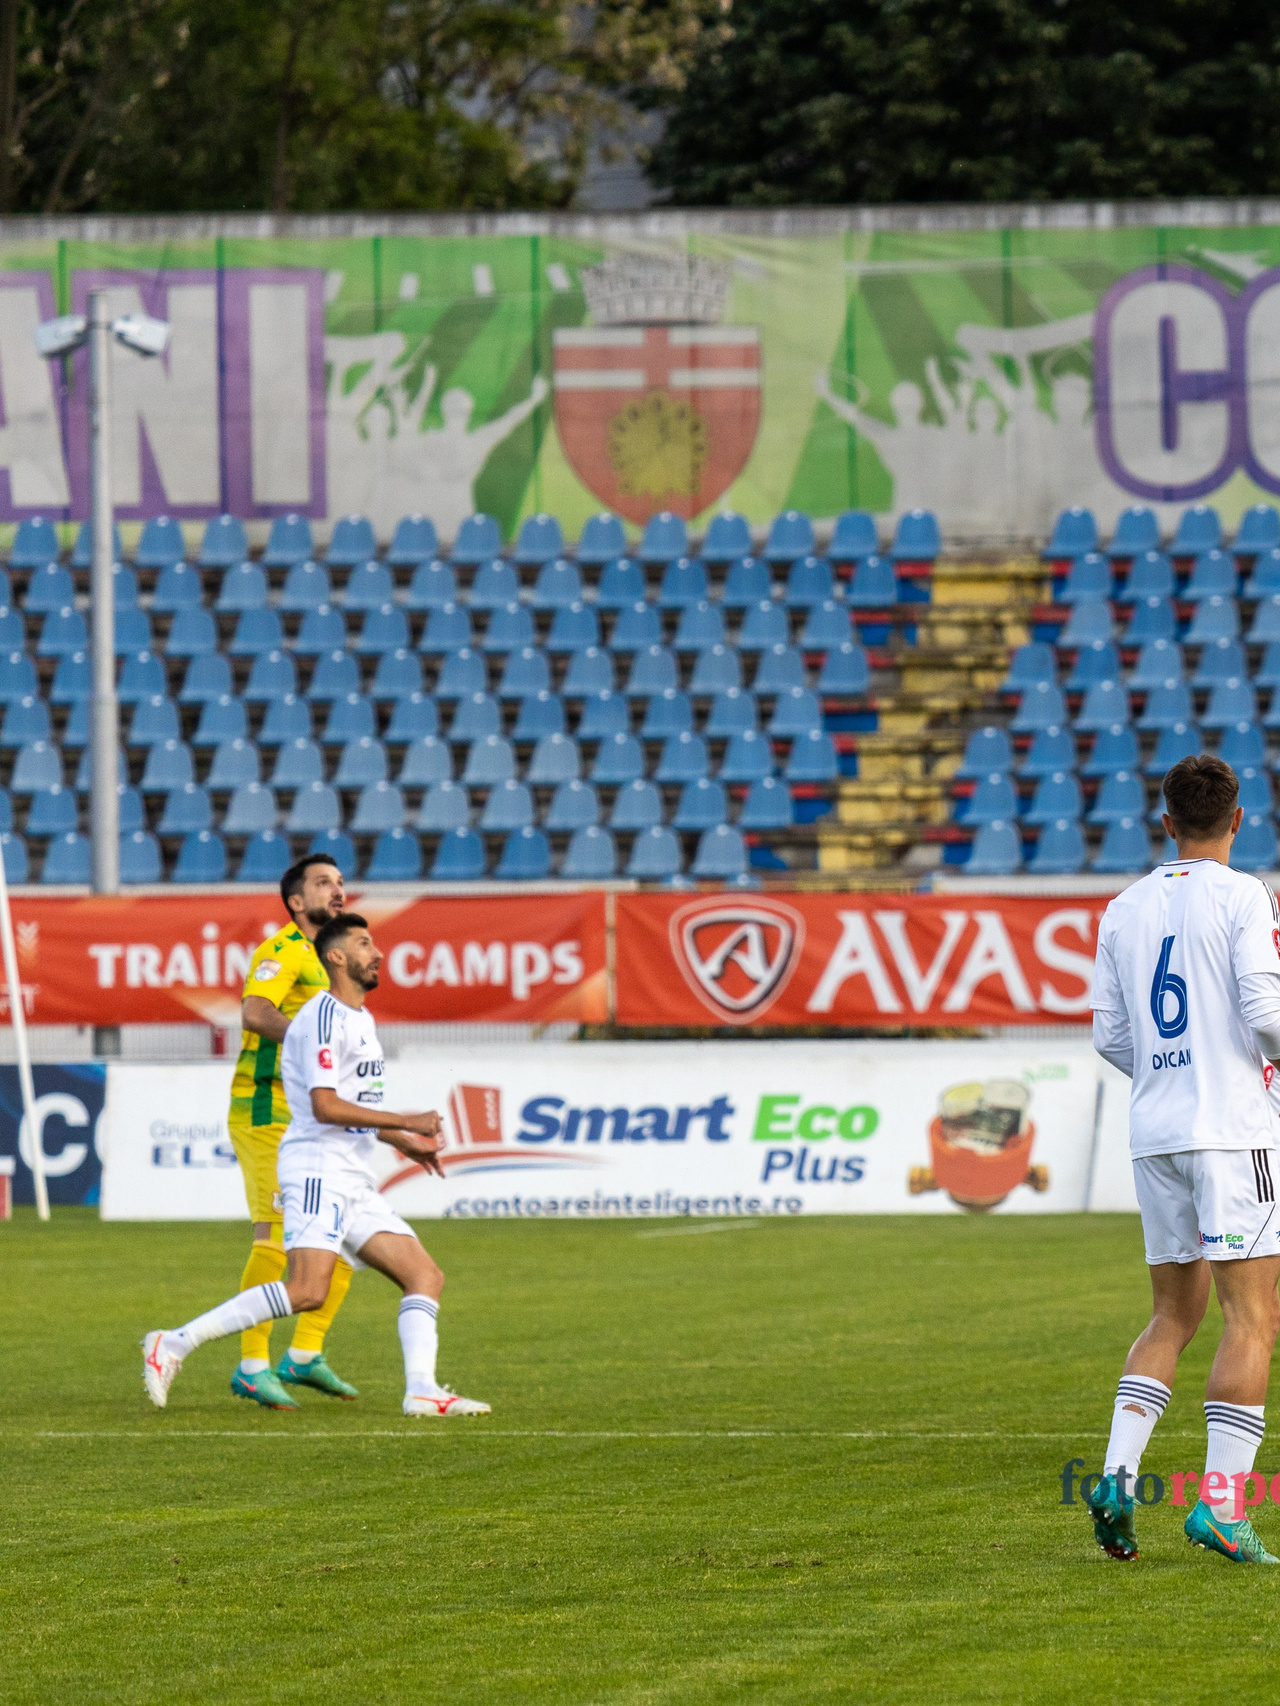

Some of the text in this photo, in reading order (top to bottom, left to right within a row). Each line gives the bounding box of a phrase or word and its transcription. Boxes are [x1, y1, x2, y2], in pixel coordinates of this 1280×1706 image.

[1151, 935, 1188, 1039] 6
[150, 1120, 221, 1141] Grupul
[516, 1093, 735, 1144] Smart
[752, 1092, 880, 1143] Eco
[761, 1146, 866, 1184] Plus
[1225, 1234, 1244, 1243] Eco
